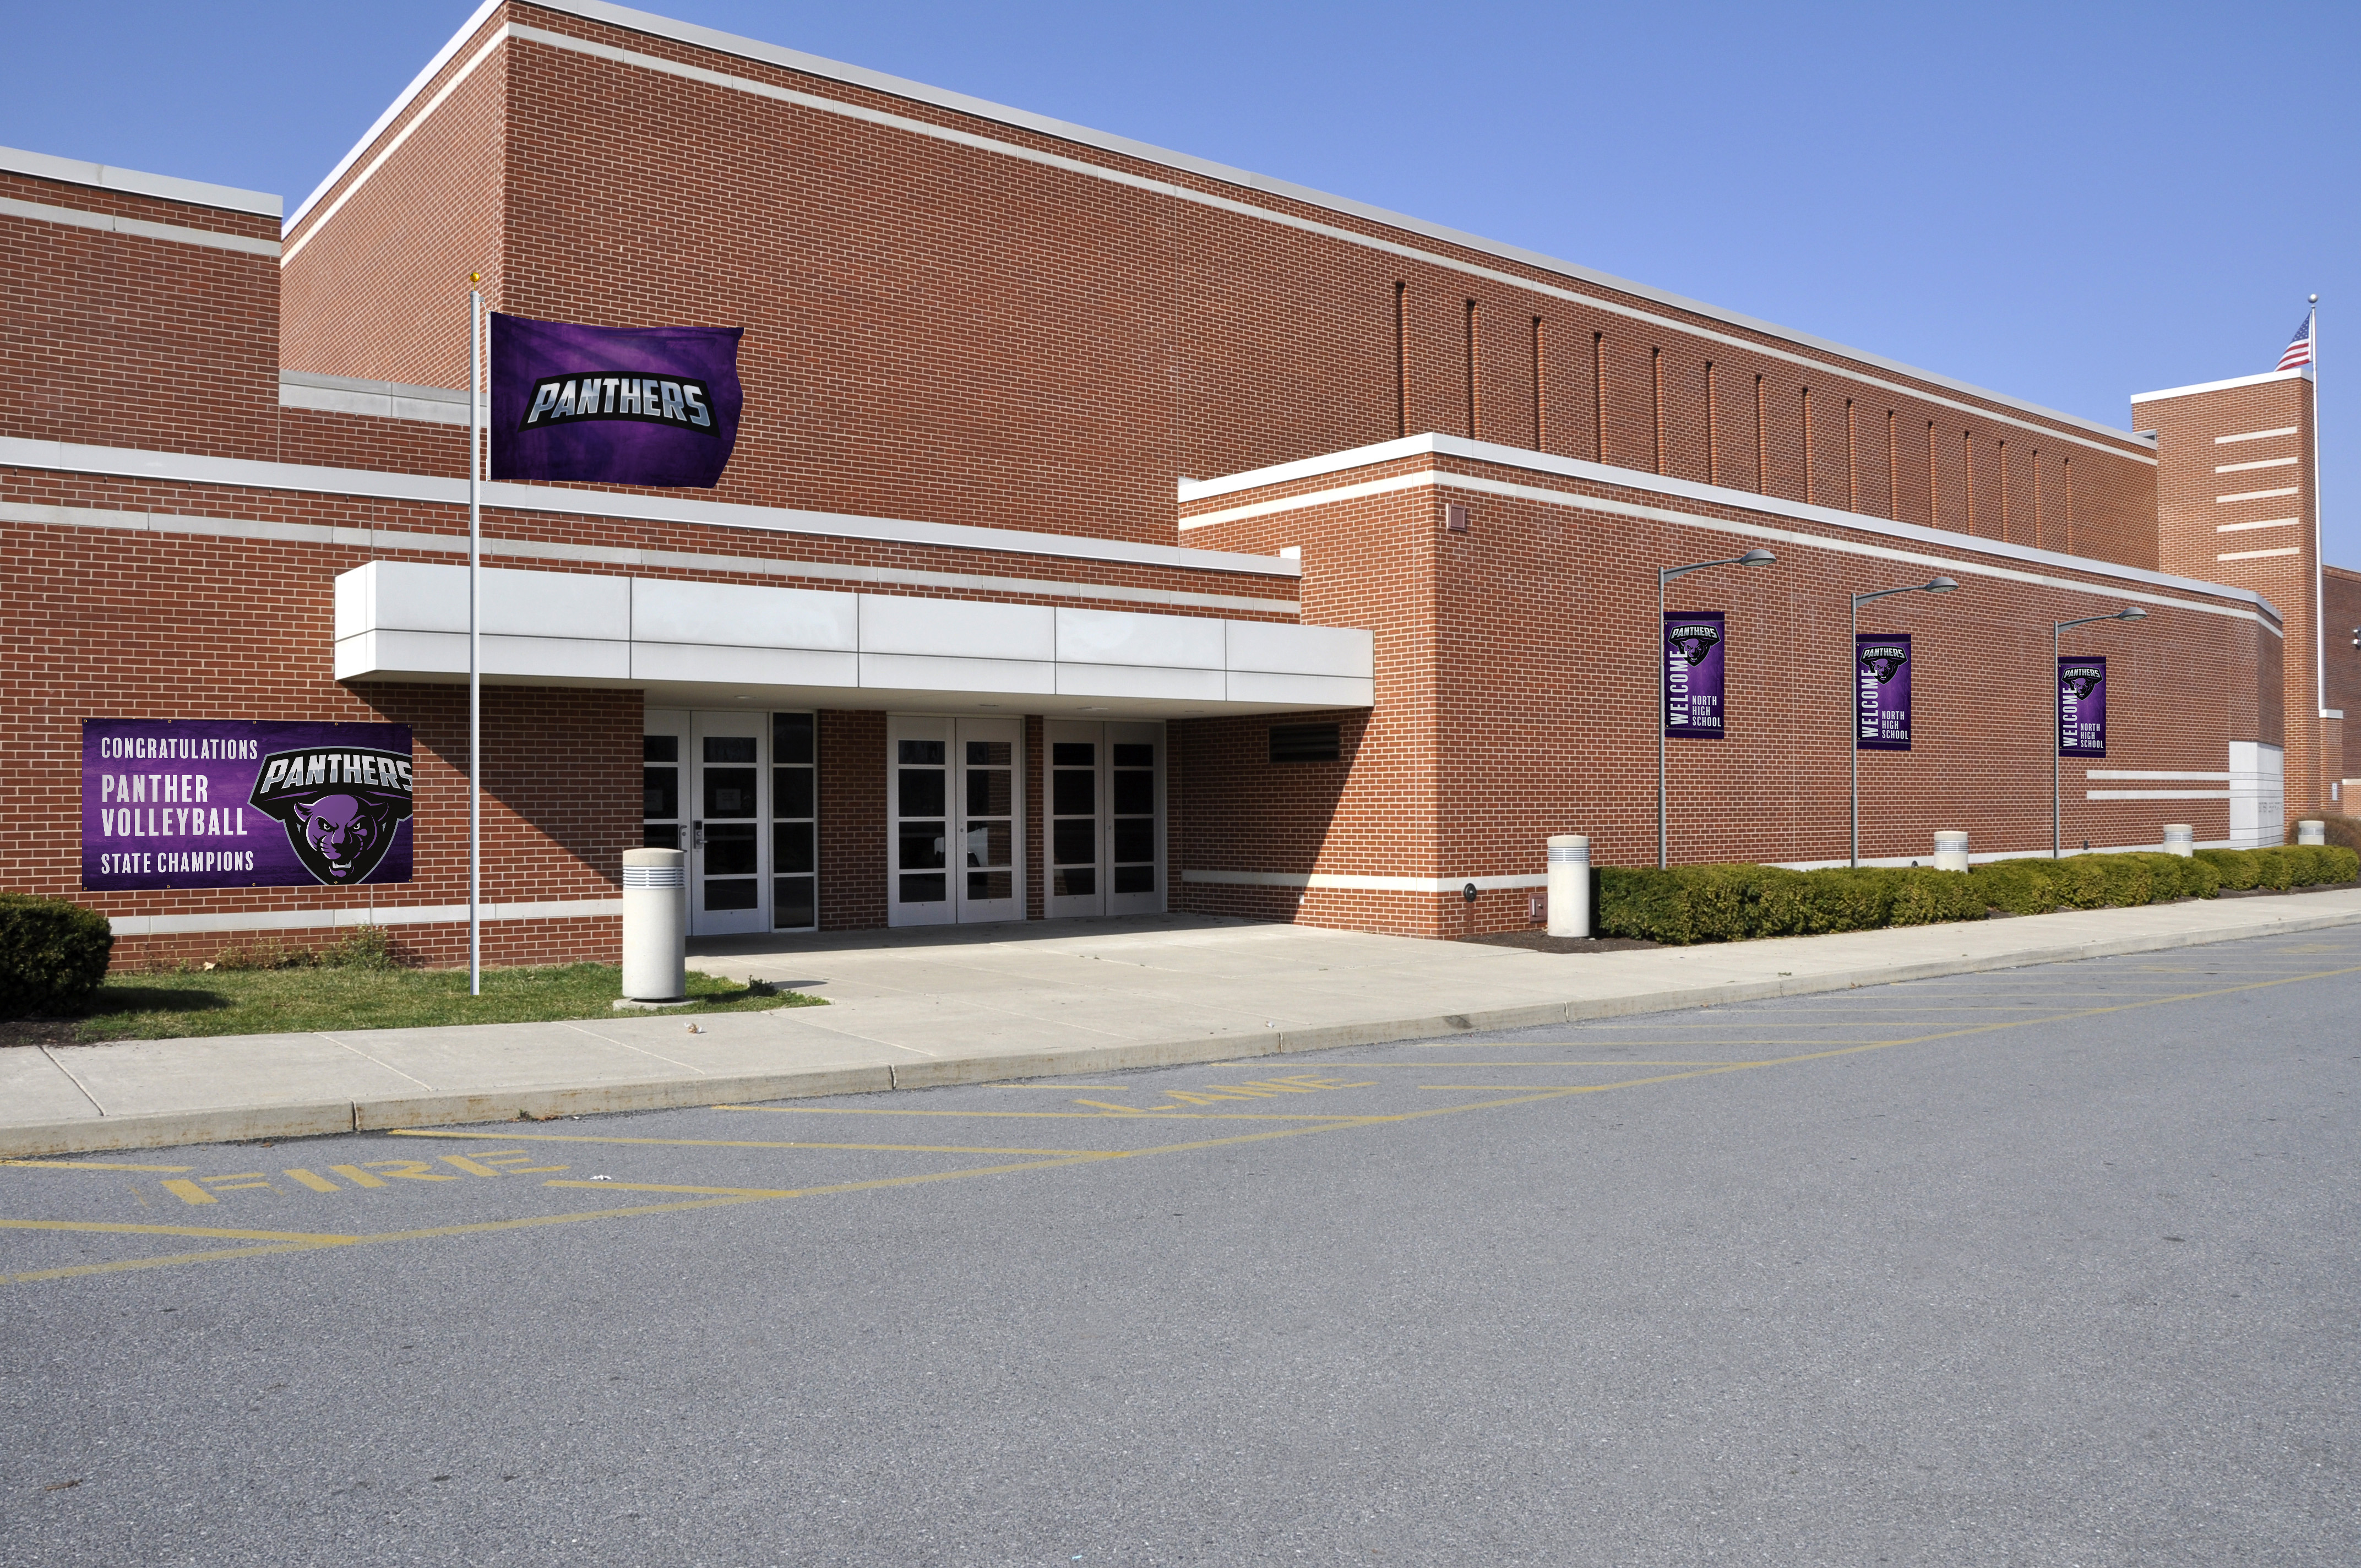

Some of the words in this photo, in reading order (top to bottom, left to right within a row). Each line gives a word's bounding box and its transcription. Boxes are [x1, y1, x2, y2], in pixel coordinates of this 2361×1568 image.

[527, 378, 710, 427] PANTHERS
[1671, 627, 1717, 639] PANTHERS
[1863, 648, 1905, 659] PANTHERS
[2064, 668, 2101, 678] PANTHERS
[1669, 650, 1689, 725] WELCOME
[1692, 695, 1717, 706] NORTH
[1692, 706, 1711, 716] HIGH
[1861, 669, 1879, 738] WELCOME
[1692, 716, 1722, 727] SCHOOL
[1882, 711, 1905, 720] NORTH
[1882, 720, 1898, 729] HIGH
[2063, 687, 2077, 747] WELCOME
[1882, 729, 1908, 739] SCHOOL
[2080, 740, 2103, 748] SCHOOL
[101, 737, 258, 760] CONGRATULATIONS
[259, 754, 413, 794] PANTHERS
[101, 774, 208, 803] PANTHER
[101, 808, 248, 837] VOLLEYBALL
[100, 852, 151, 874] STATE
[157, 851, 253, 873] CHAMPIONS
[1075, 1074, 1378, 1113] LANE
[160, 1149, 571, 1206] FIRE
